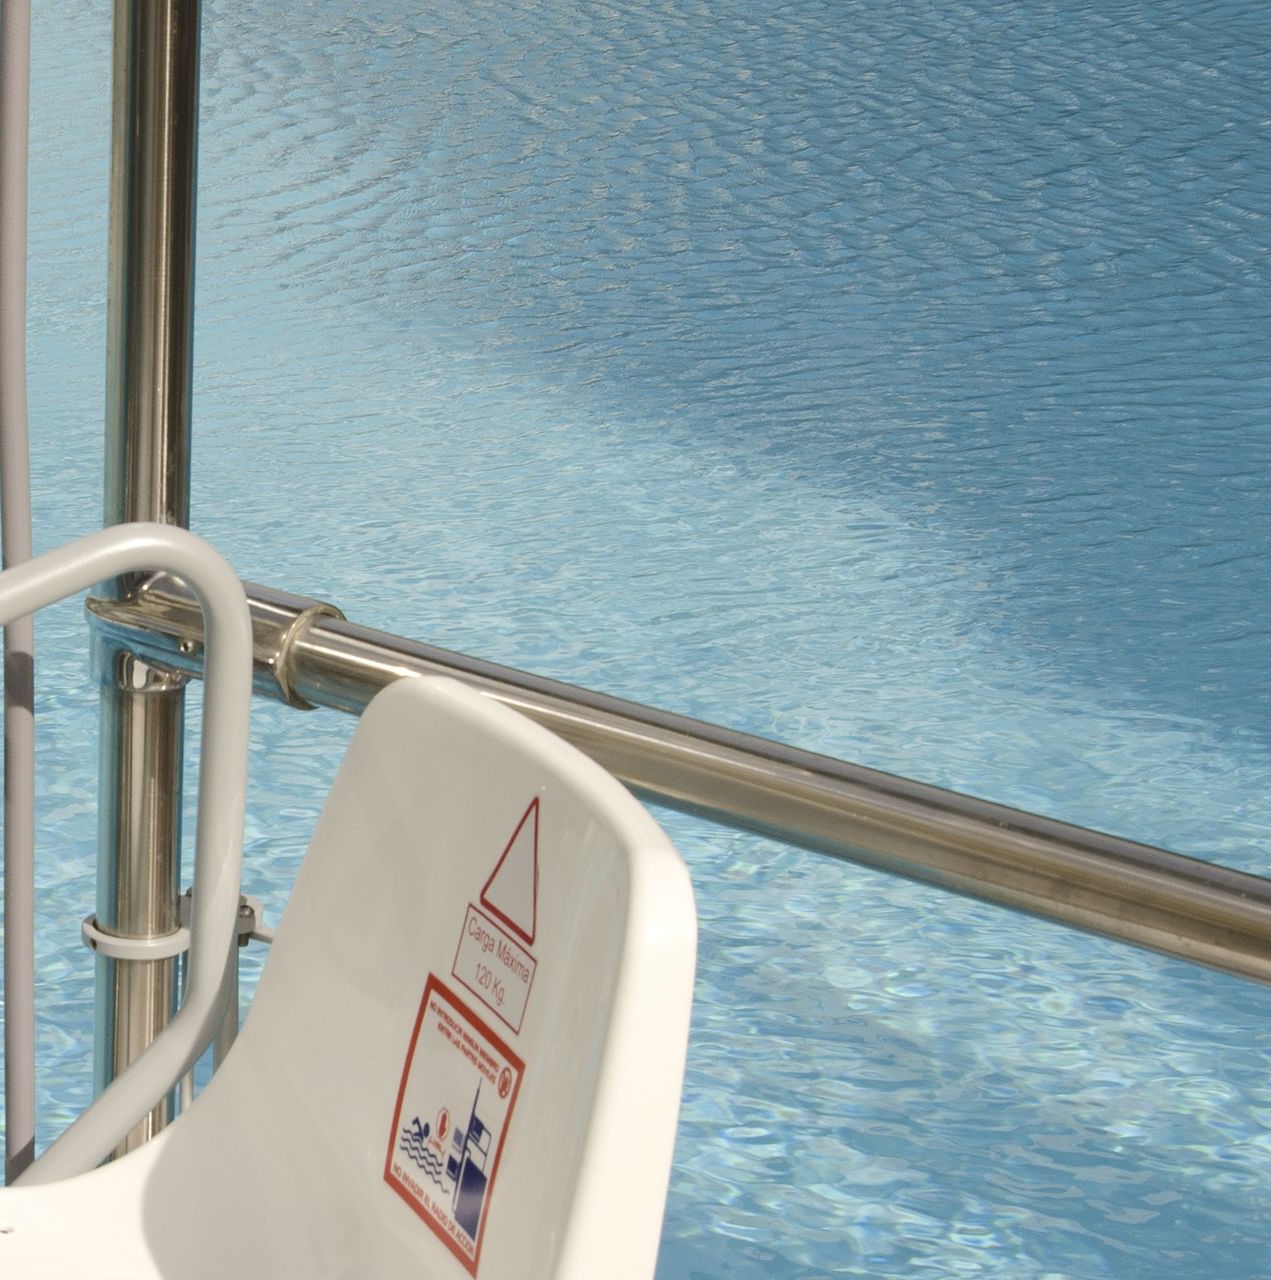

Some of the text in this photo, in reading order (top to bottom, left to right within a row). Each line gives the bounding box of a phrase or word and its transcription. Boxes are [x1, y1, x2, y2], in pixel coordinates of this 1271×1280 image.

[469, 917, 530, 984] Carga Máxima
[475, 963, 492, 989] 120
